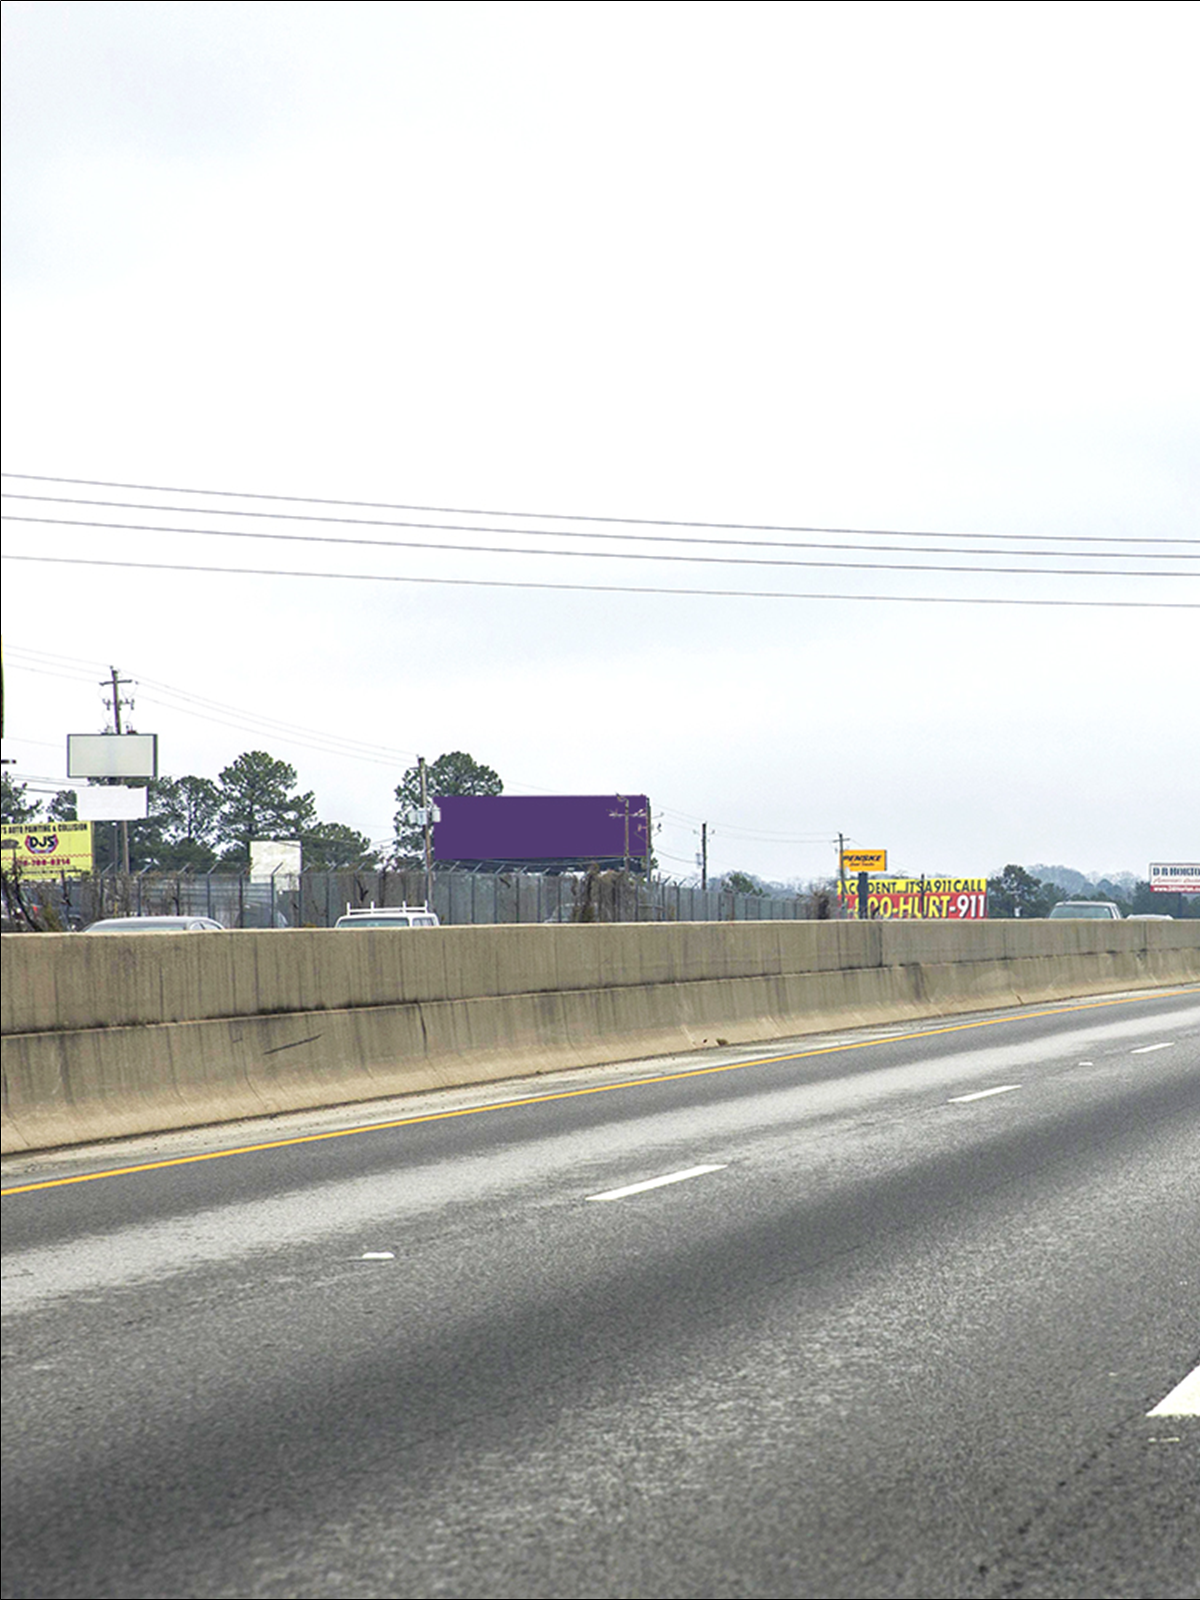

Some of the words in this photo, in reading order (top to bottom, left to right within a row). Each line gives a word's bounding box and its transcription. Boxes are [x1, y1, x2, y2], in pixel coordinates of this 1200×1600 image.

[843, 854, 882, 862] PENSKE
[934, 880, 952, 893] 911
[953, 879, 983, 893] CALL
